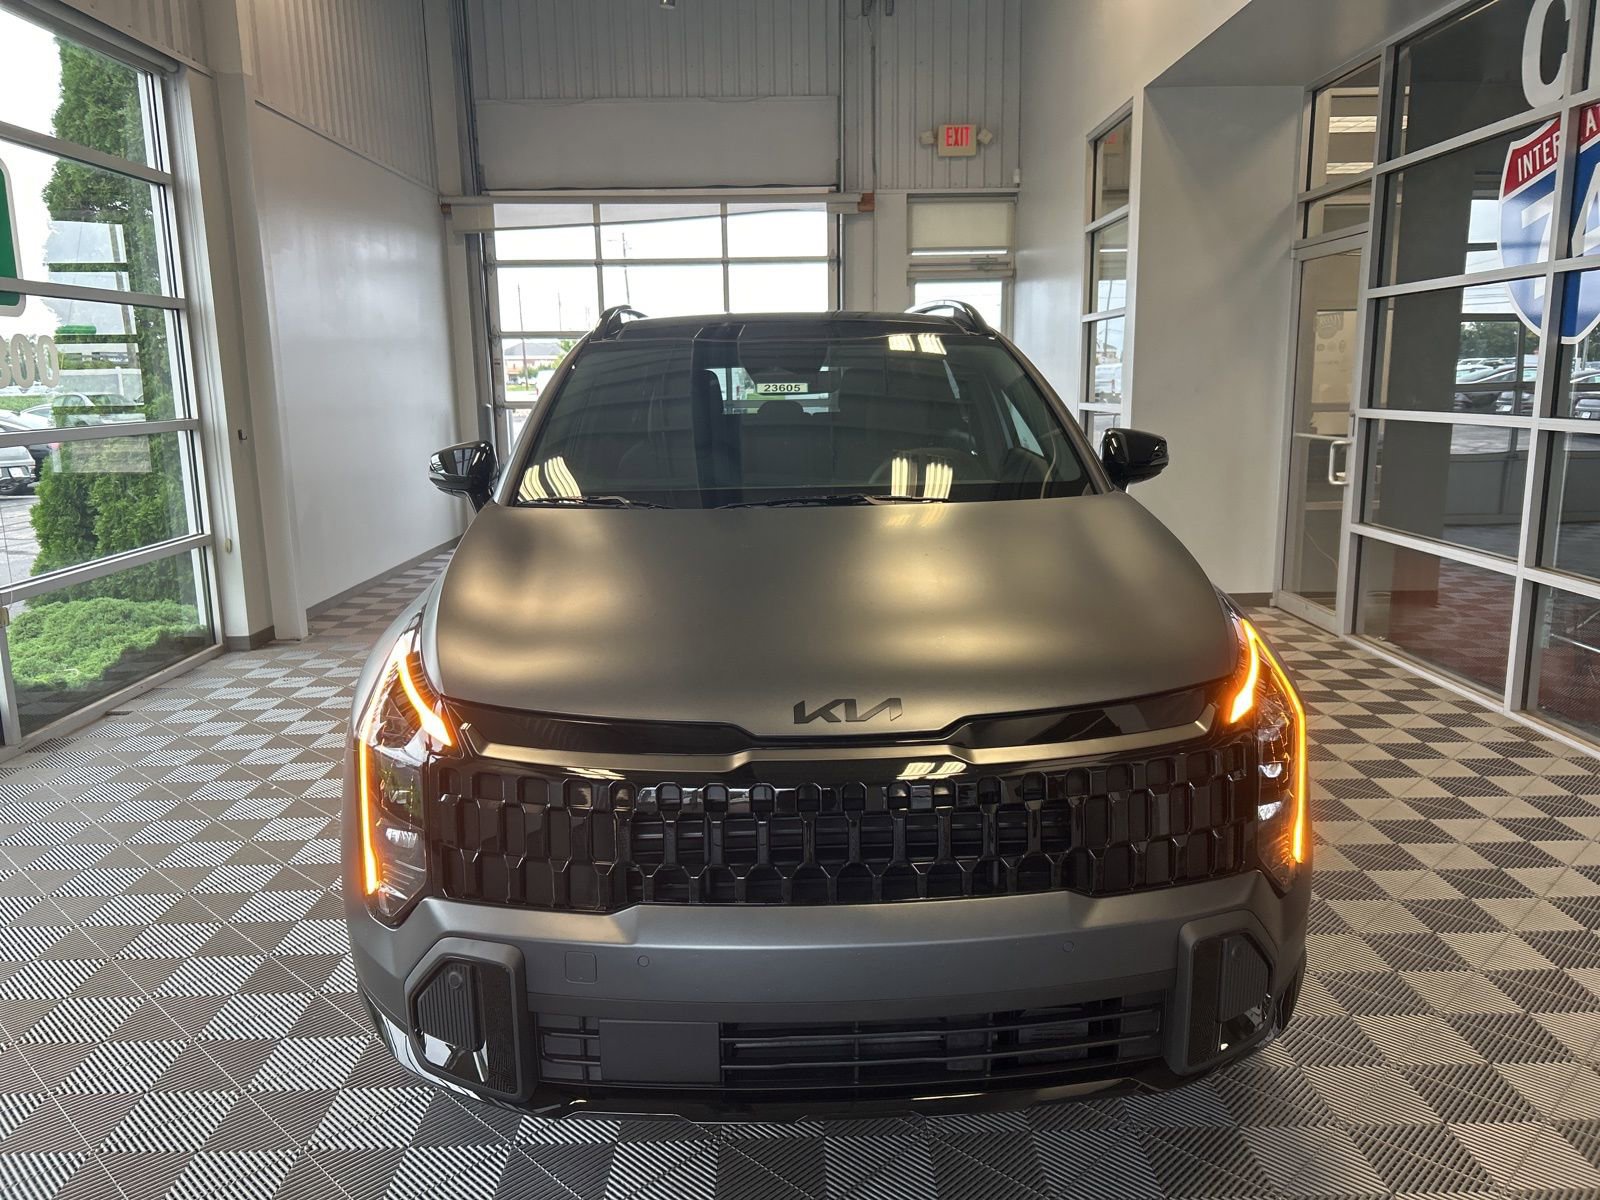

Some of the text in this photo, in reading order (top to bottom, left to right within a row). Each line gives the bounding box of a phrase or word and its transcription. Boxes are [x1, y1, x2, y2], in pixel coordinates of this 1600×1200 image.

[945, 127, 969, 147] EXIT
[764, 384, 801, 392] 23605
[793, 698, 902, 724] KIA
